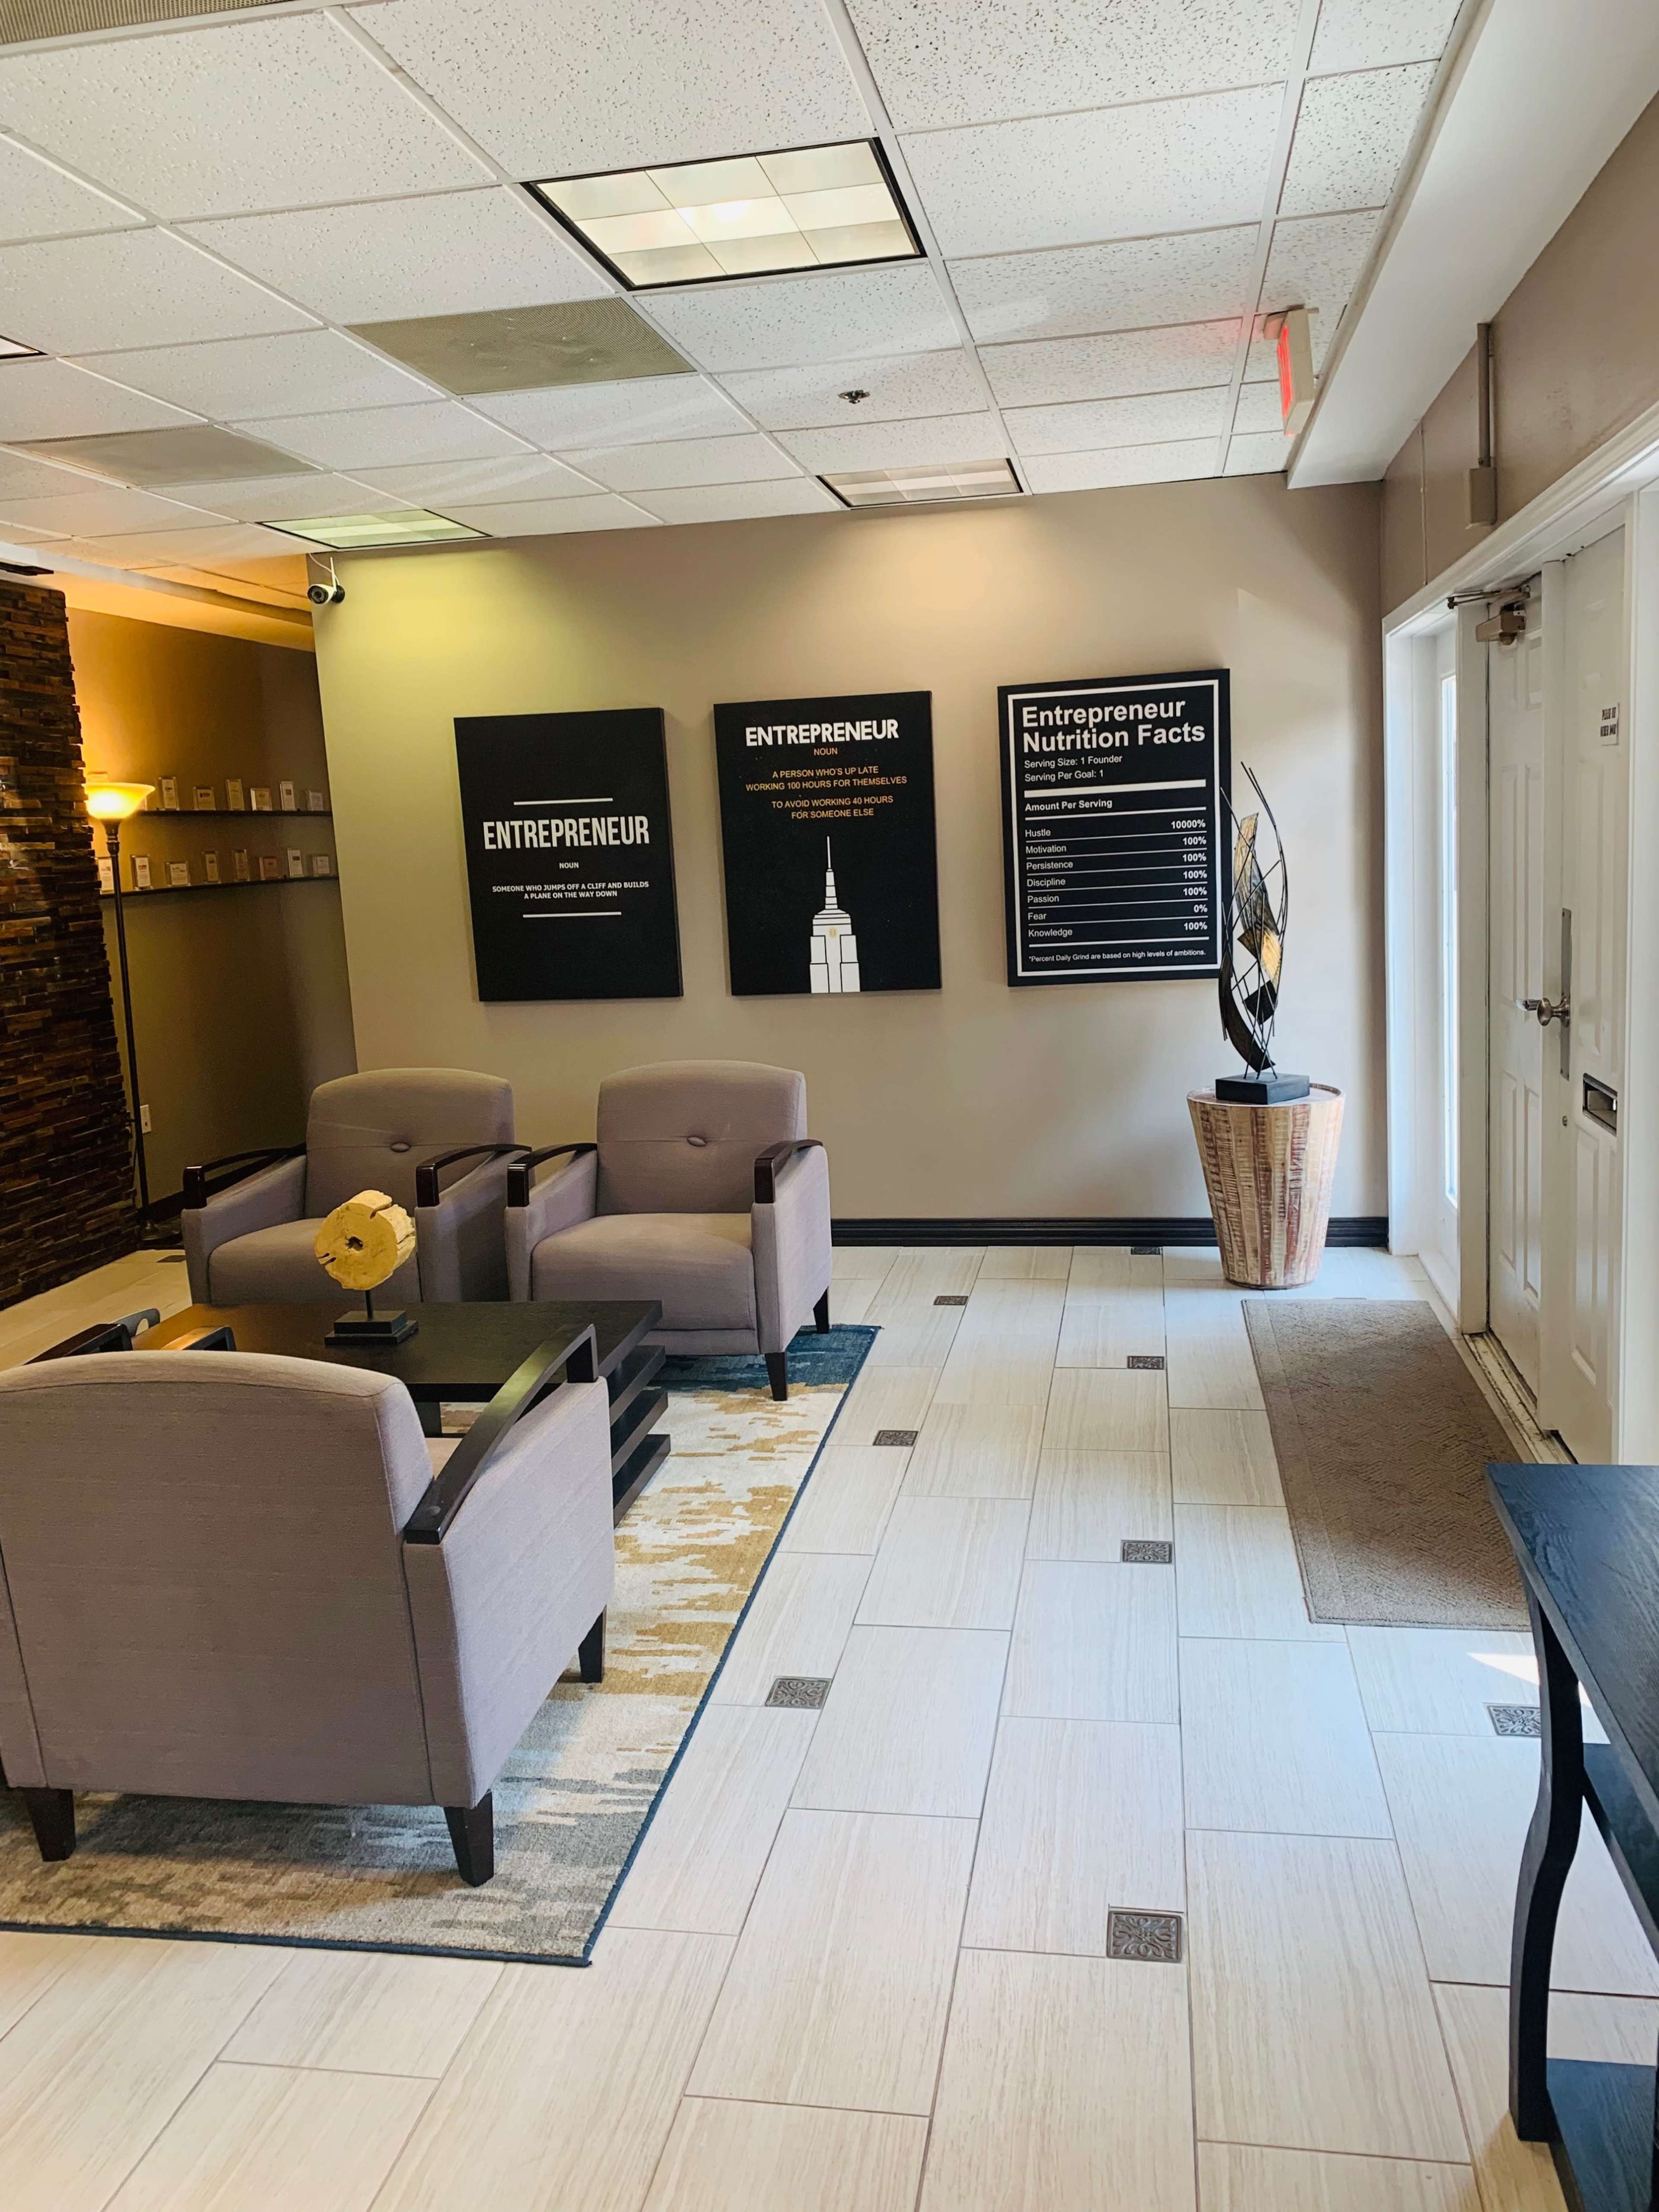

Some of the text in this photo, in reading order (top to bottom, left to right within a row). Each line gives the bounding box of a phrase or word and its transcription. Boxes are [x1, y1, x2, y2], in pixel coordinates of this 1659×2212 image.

[1023, 701, 1185, 728] Entrepreneur
[746, 719, 899, 746] ENTREPRENEUR
[1023, 722, 1205, 753] Nutrition Facts
[814, 747, 838, 756] NOUN
[1024, 759, 1055, 769] Serving
[1058, 758, 1077, 766] Size:
[1088, 755, 1122, 764] Founder
[780, 769, 814, 778] PERSON
[815, 768, 843, 776] WHO'S
[858, 766, 878, 774] LATE
[1025, 773, 1055, 782] Serving
[1058, 772, 1072, 780] Per
[1074, 769, 1096, 779] Goal:
[746, 782, 785, 791] WORKING
[802, 780, 831, 788] HOURS
[852, 776, 907, 786] THEMSELVES
[785, 800, 810, 808] AVOID
[811, 798, 851, 807] WORKING
[864, 795, 893, 804] HOURS
[1025, 802, 1059, 811] Amount
[1079, 799, 1112, 808] Serving
[791, 808, 874, 819] FOR SOMEONE ELSE
[483, 816, 649, 849] ENTREPRENEUR
[1025, 819, 1206, 837] Hustle 10000%
[1026, 836, 1206, 854] Motivation 100%
[1027, 853, 1207, 870] Persistence 100%
[1027, 870, 1207, 887] Discipline 100%
[1027, 887, 1207, 903] Passion 100%
[1194, 904, 1208, 913] 0%
[1028, 922, 1208, 938] Knowledge 100%
